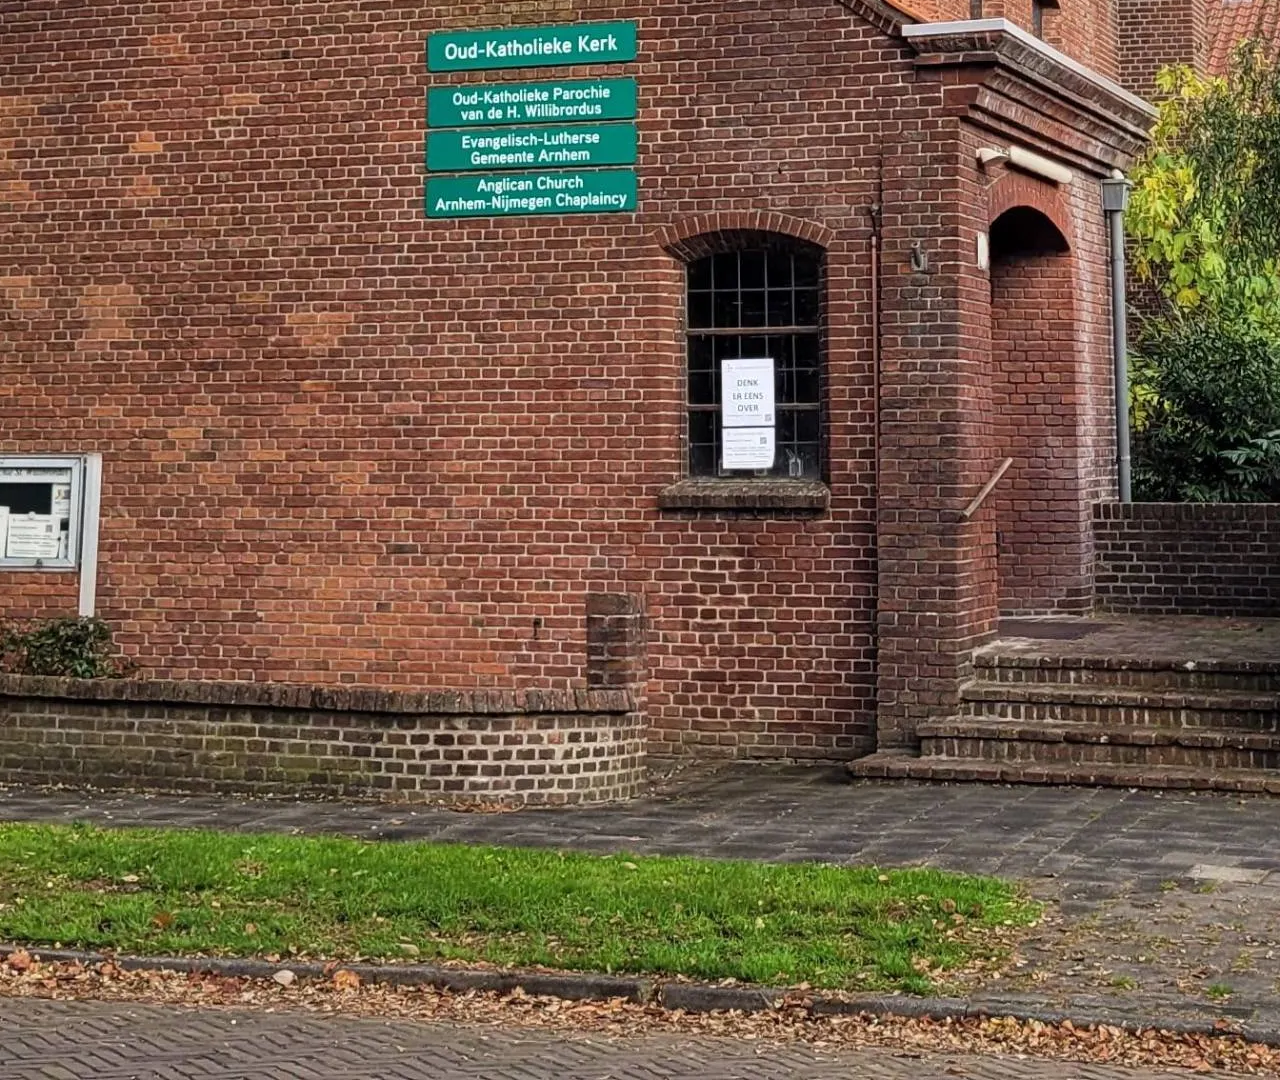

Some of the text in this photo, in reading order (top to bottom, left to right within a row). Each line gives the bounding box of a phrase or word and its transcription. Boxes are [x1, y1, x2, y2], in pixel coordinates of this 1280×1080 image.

[444, 33, 618, 60] Oud-Katholieke Kerk
[452, 85, 611, 106] Oud-Katholieke Parochie
[461, 102, 602, 121] van de H. Willibrordus
[461, 131, 601, 150] Evangelisch-Lutherse
[470, 149, 591, 165] Gemeente Arnhem
[476, 175, 584, 195] Anglican Church
[435, 191, 628, 213] Arnhem-Nijmegen Chaplaincy
[737, 379, 759, 387] DENK
[737, 404, 759, 412] OVER
